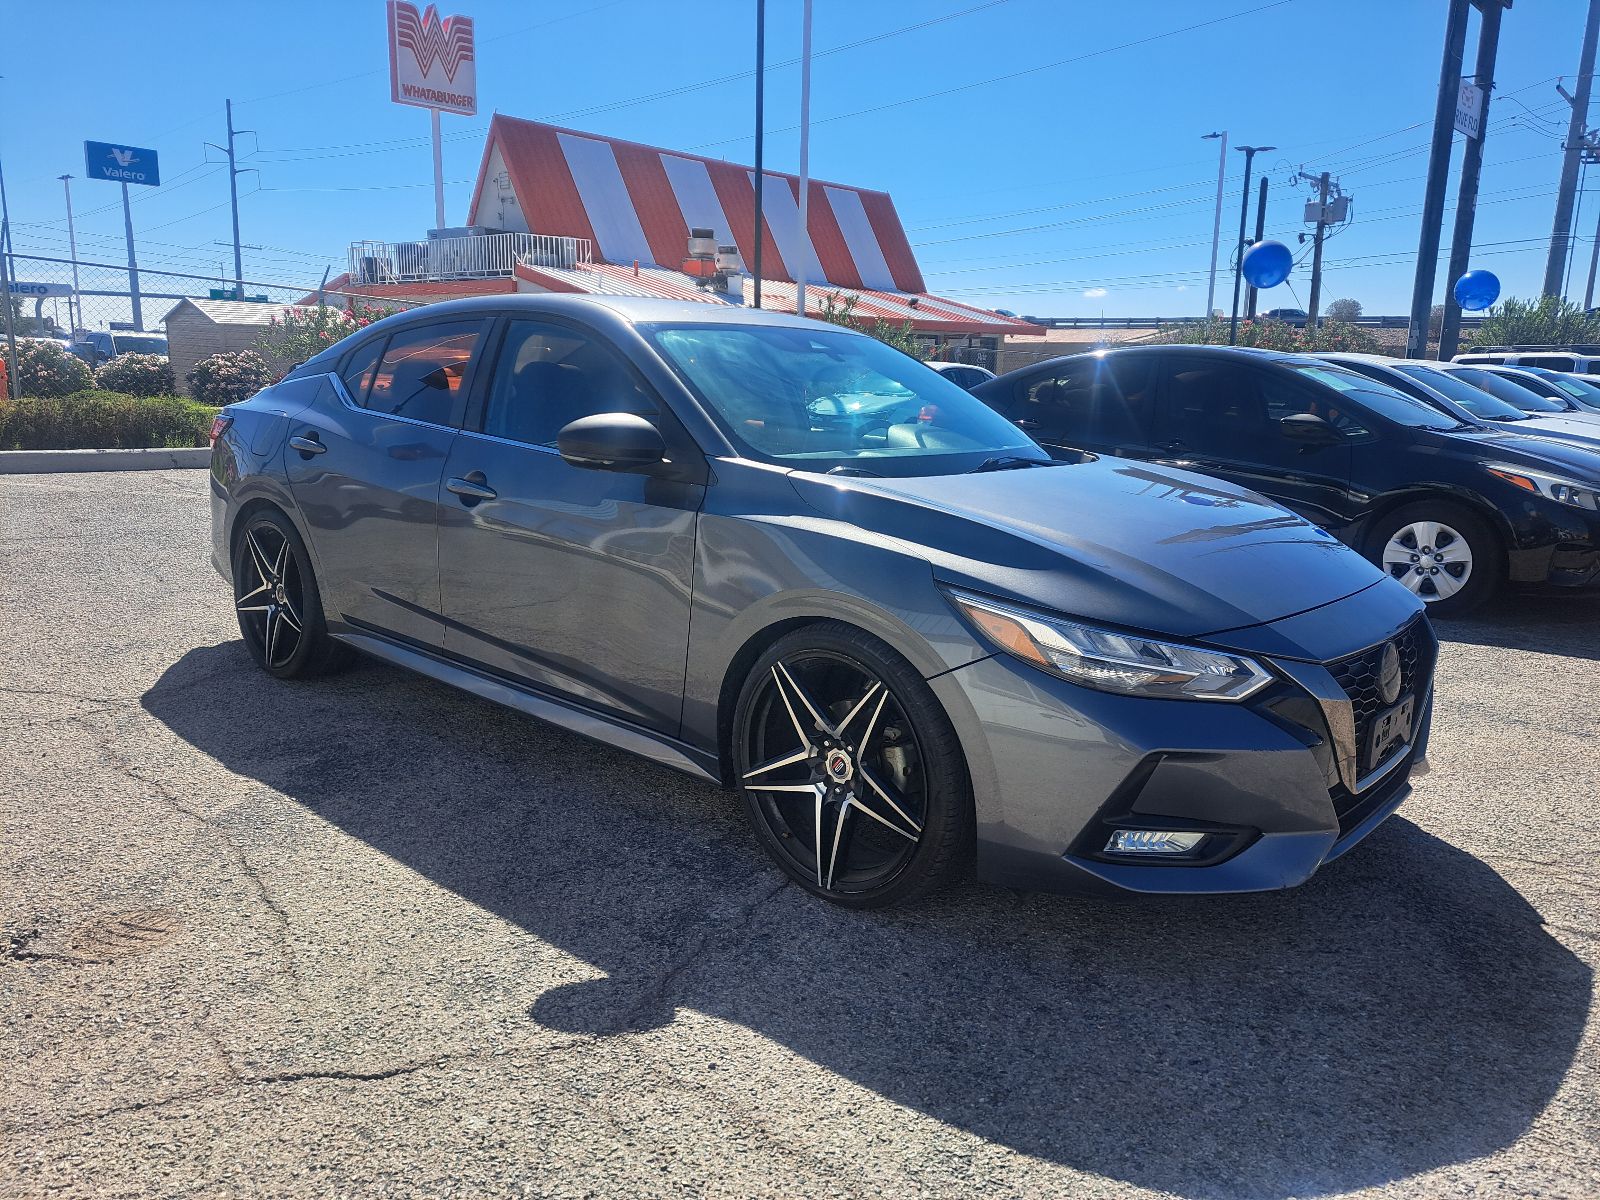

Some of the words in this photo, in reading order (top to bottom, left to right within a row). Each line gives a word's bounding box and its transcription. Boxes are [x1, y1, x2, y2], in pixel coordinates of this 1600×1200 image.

[402, 84, 473, 108] WHATABURGER
[102, 166, 145, 181] Valero
[8, 282, 48, 294] alero
